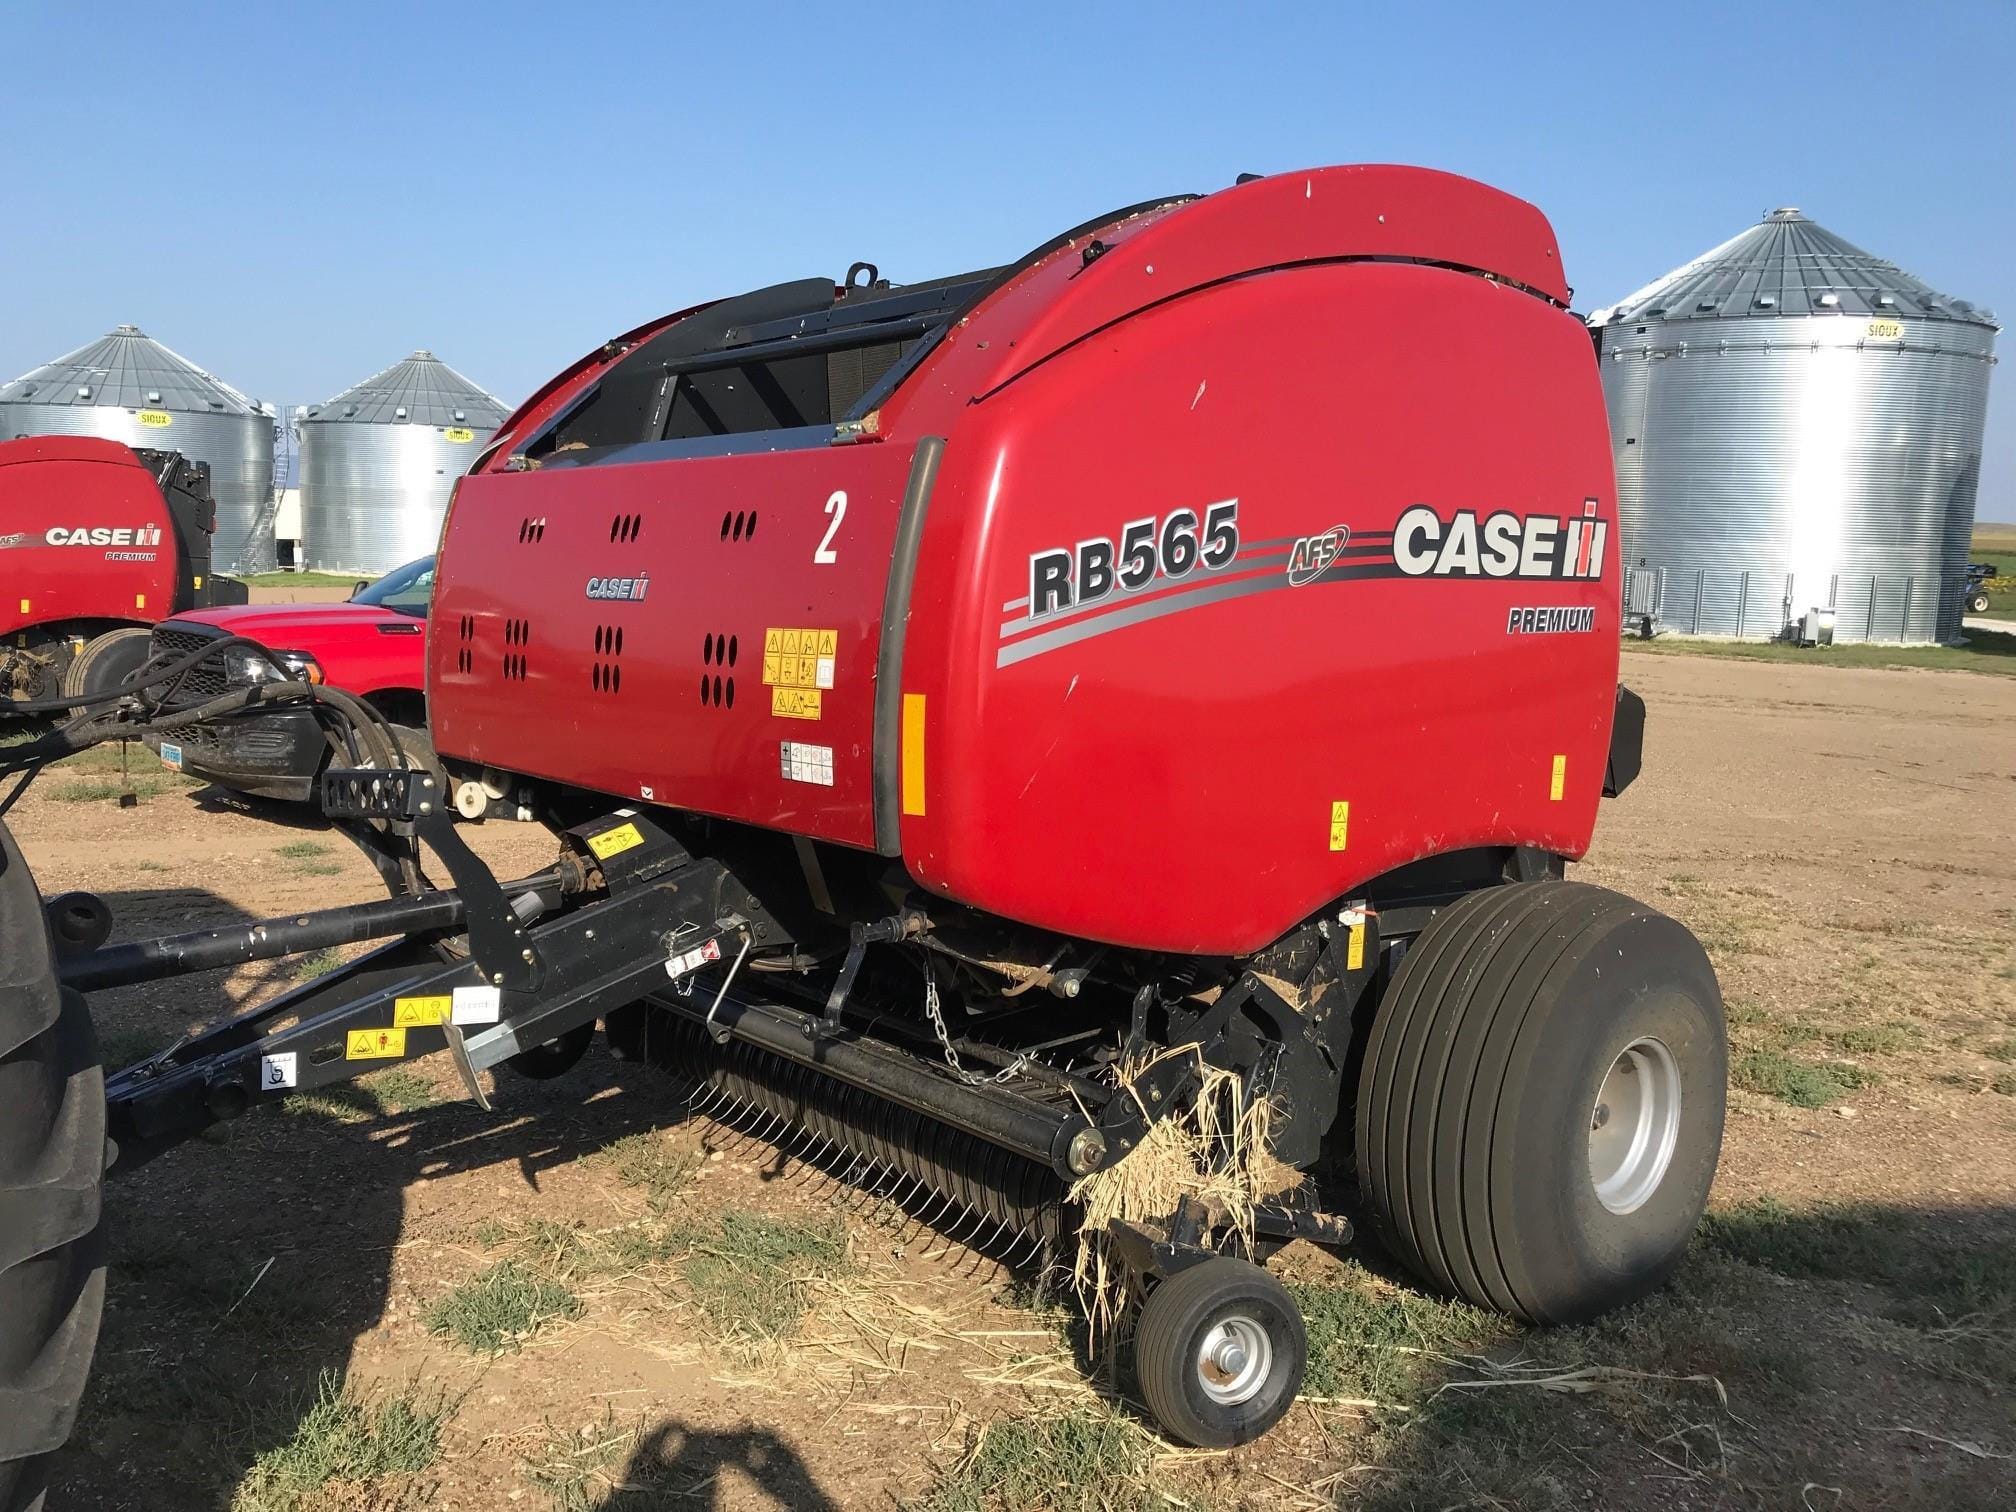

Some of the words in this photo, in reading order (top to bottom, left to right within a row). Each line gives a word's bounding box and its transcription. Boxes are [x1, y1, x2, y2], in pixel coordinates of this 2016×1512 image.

[1868, 324, 1898, 337] SIOUX
[141, 414, 167, 424] SIOUX
[45, 527, 132, 546] CASE
[814, 490, 847, 564] 2
[1287, 533, 1338, 573] AFS
[1393, 507, 1560, 578] CASE
[105, 551, 156, 561] PREMIUM
[1029, 498, 1239, 621] RB565
[586, 577, 632, 599] CASE
[1506, 607, 1595, 634] PREMIUM
